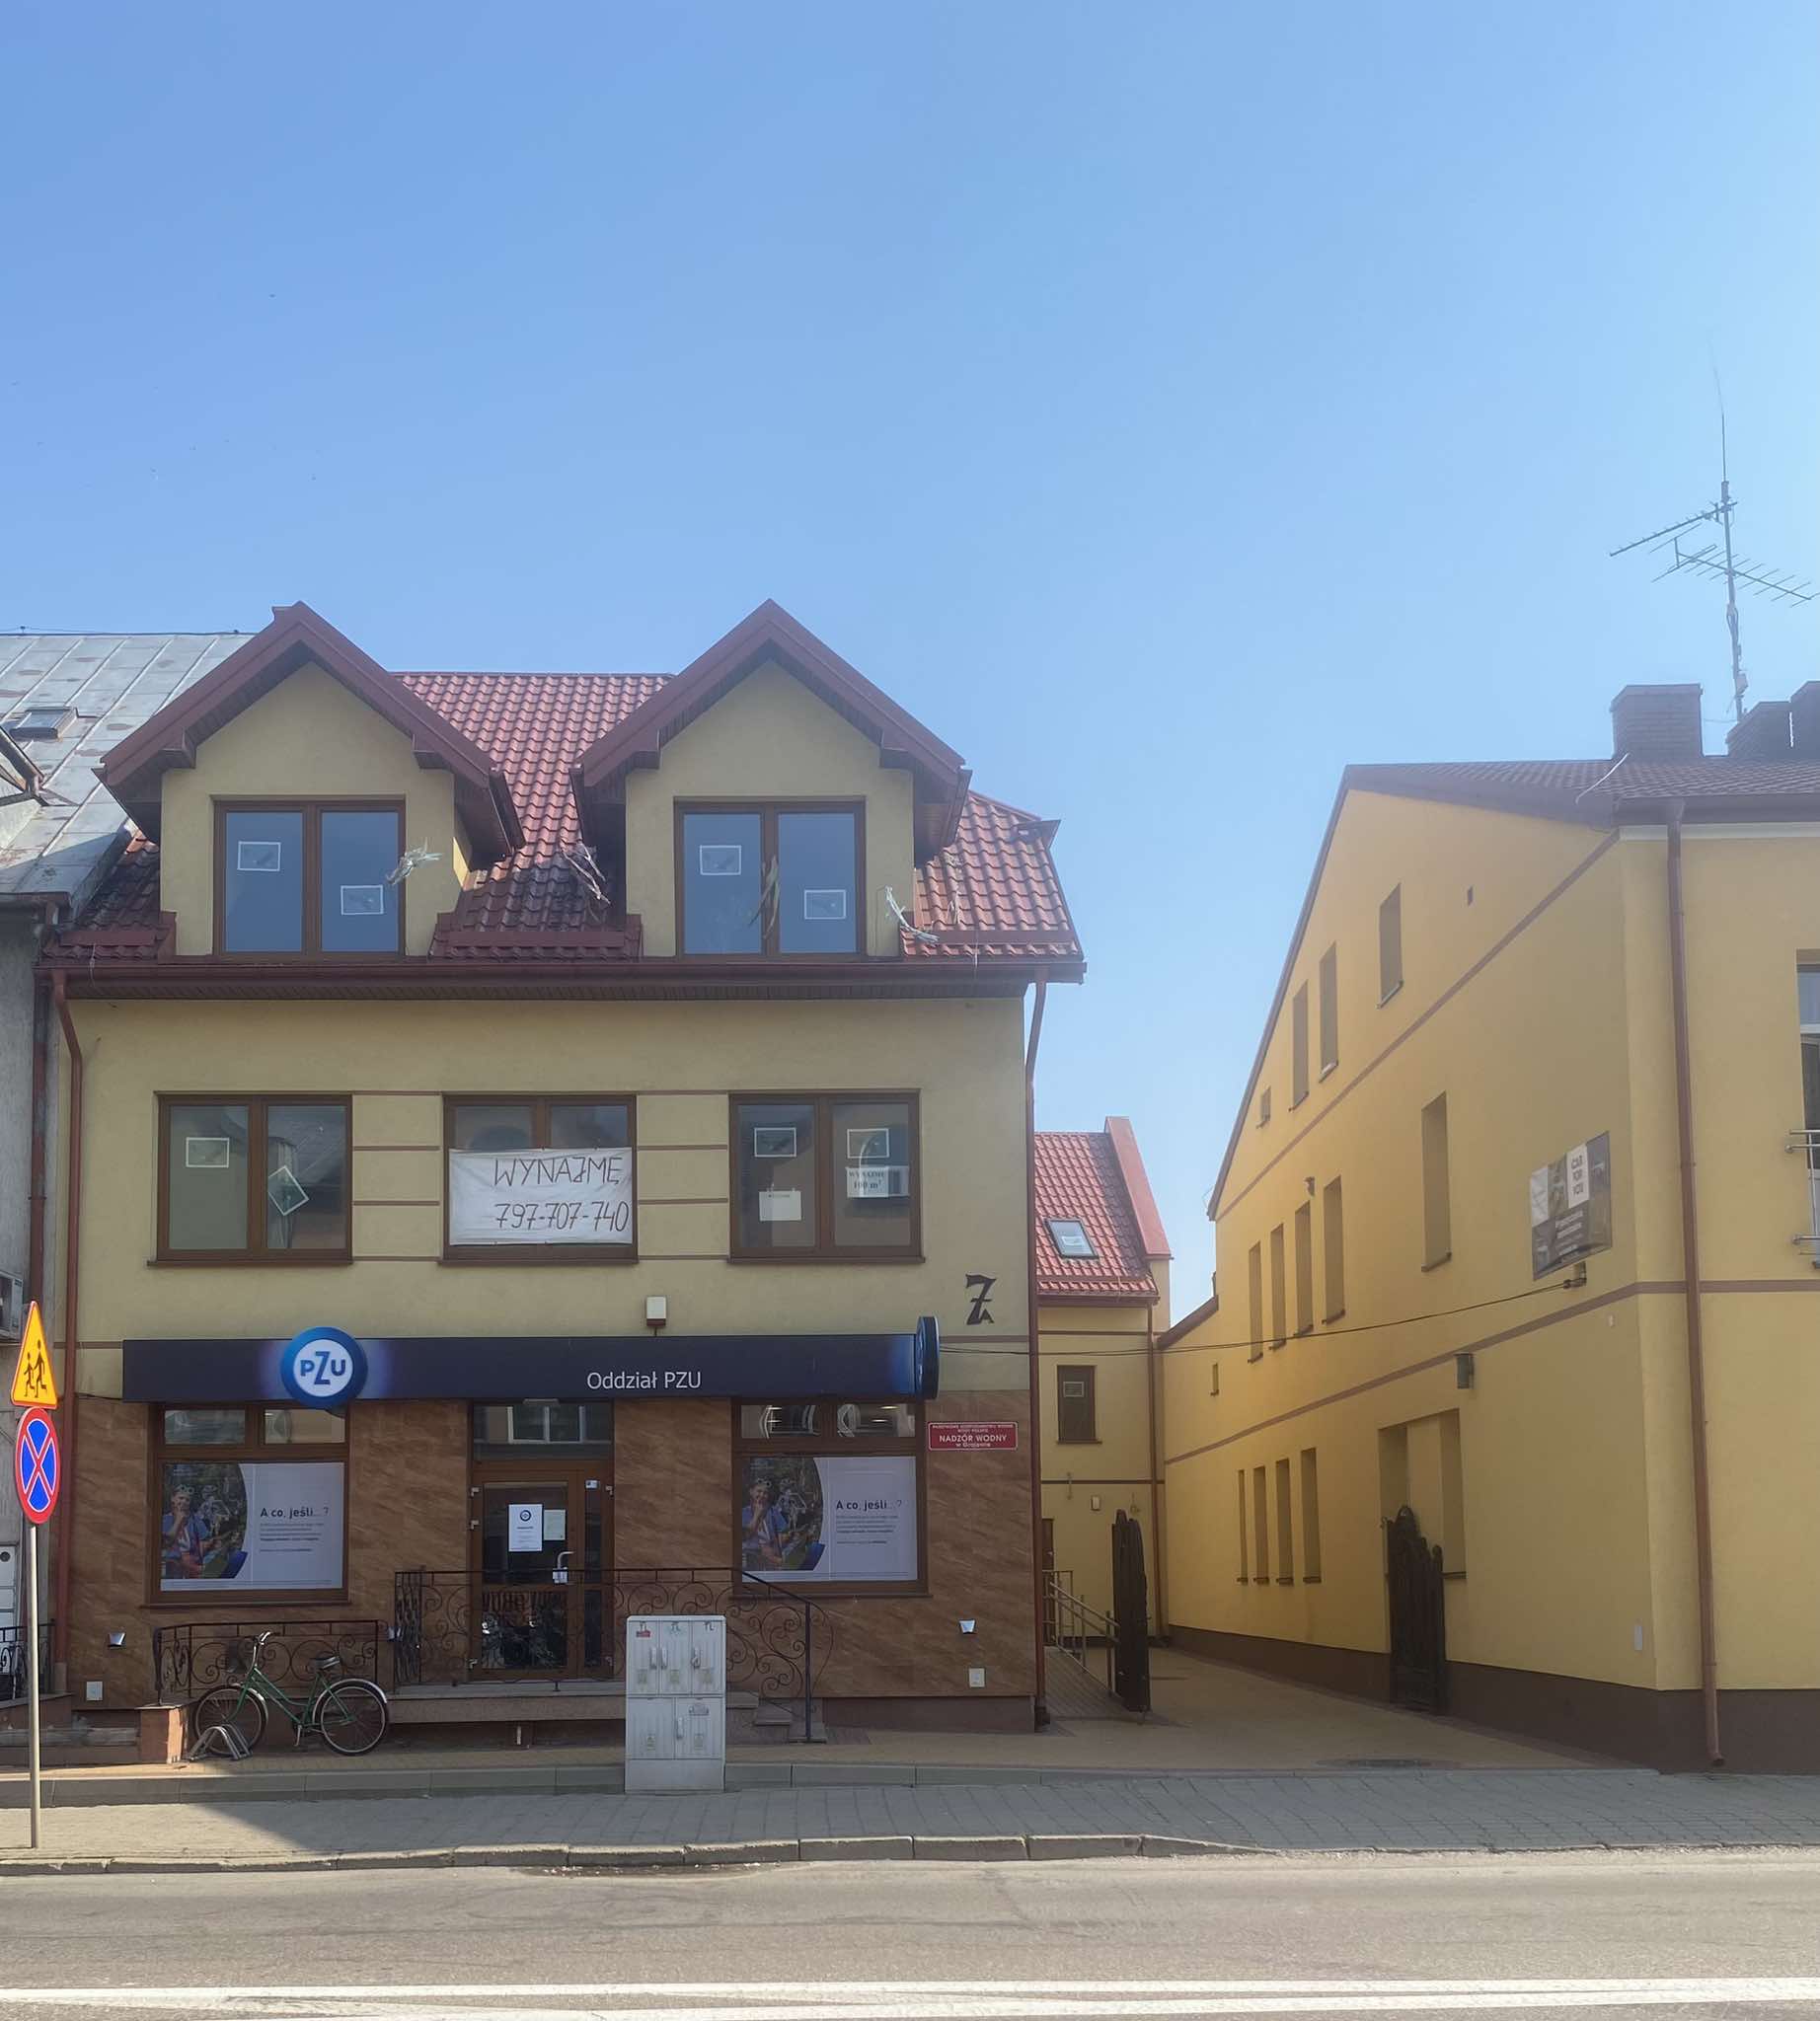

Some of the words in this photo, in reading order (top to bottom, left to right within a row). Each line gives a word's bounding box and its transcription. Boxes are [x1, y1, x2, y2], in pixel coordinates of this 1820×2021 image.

[494, 1200, 630, 1233] 797-707-740
[300, 1350, 346, 1385] PZU
[586, 1371, 658, 1389] Oddział
[663, 1371, 702, 1389] PZU
[260, 1507, 268, 1518] A
[836, 1500, 844, 1510] A
